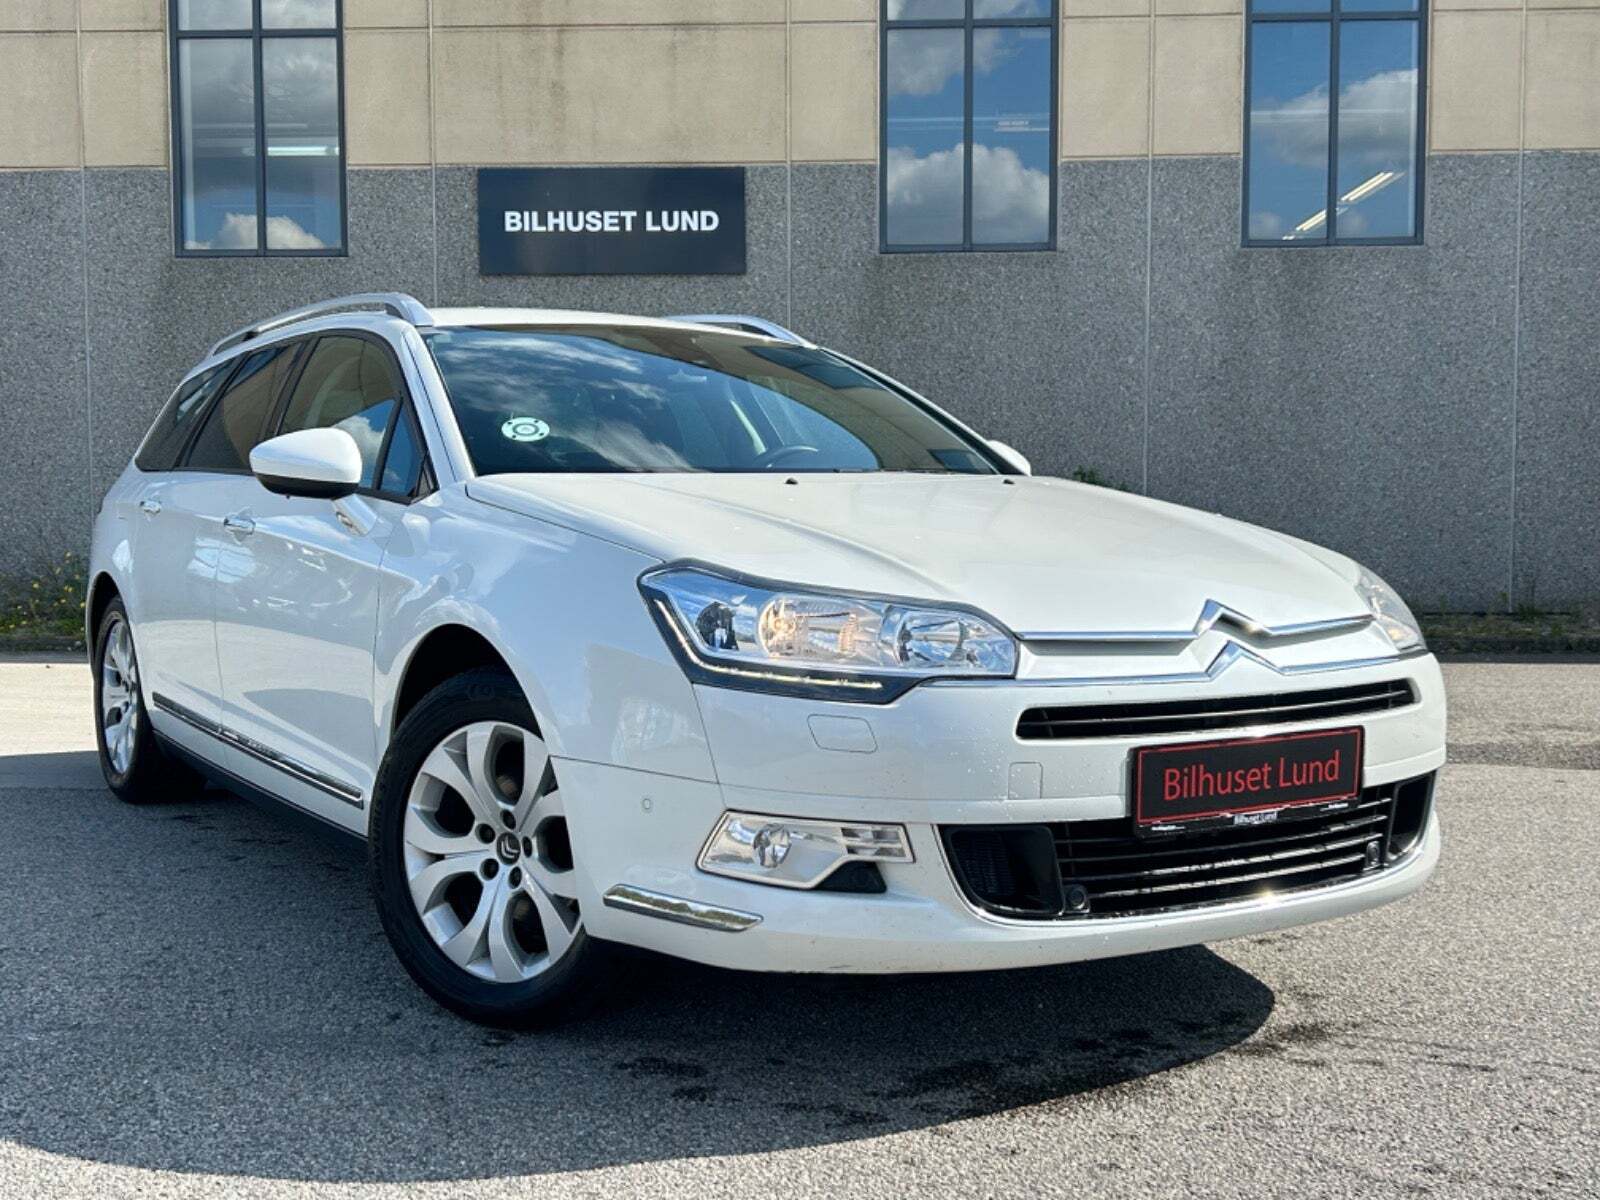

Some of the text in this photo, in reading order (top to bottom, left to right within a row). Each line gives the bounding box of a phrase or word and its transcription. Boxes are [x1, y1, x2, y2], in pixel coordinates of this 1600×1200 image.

[504, 210, 719, 233] BILHUSET LUND
[1163, 750, 1341, 801] Bilhuset Lund
